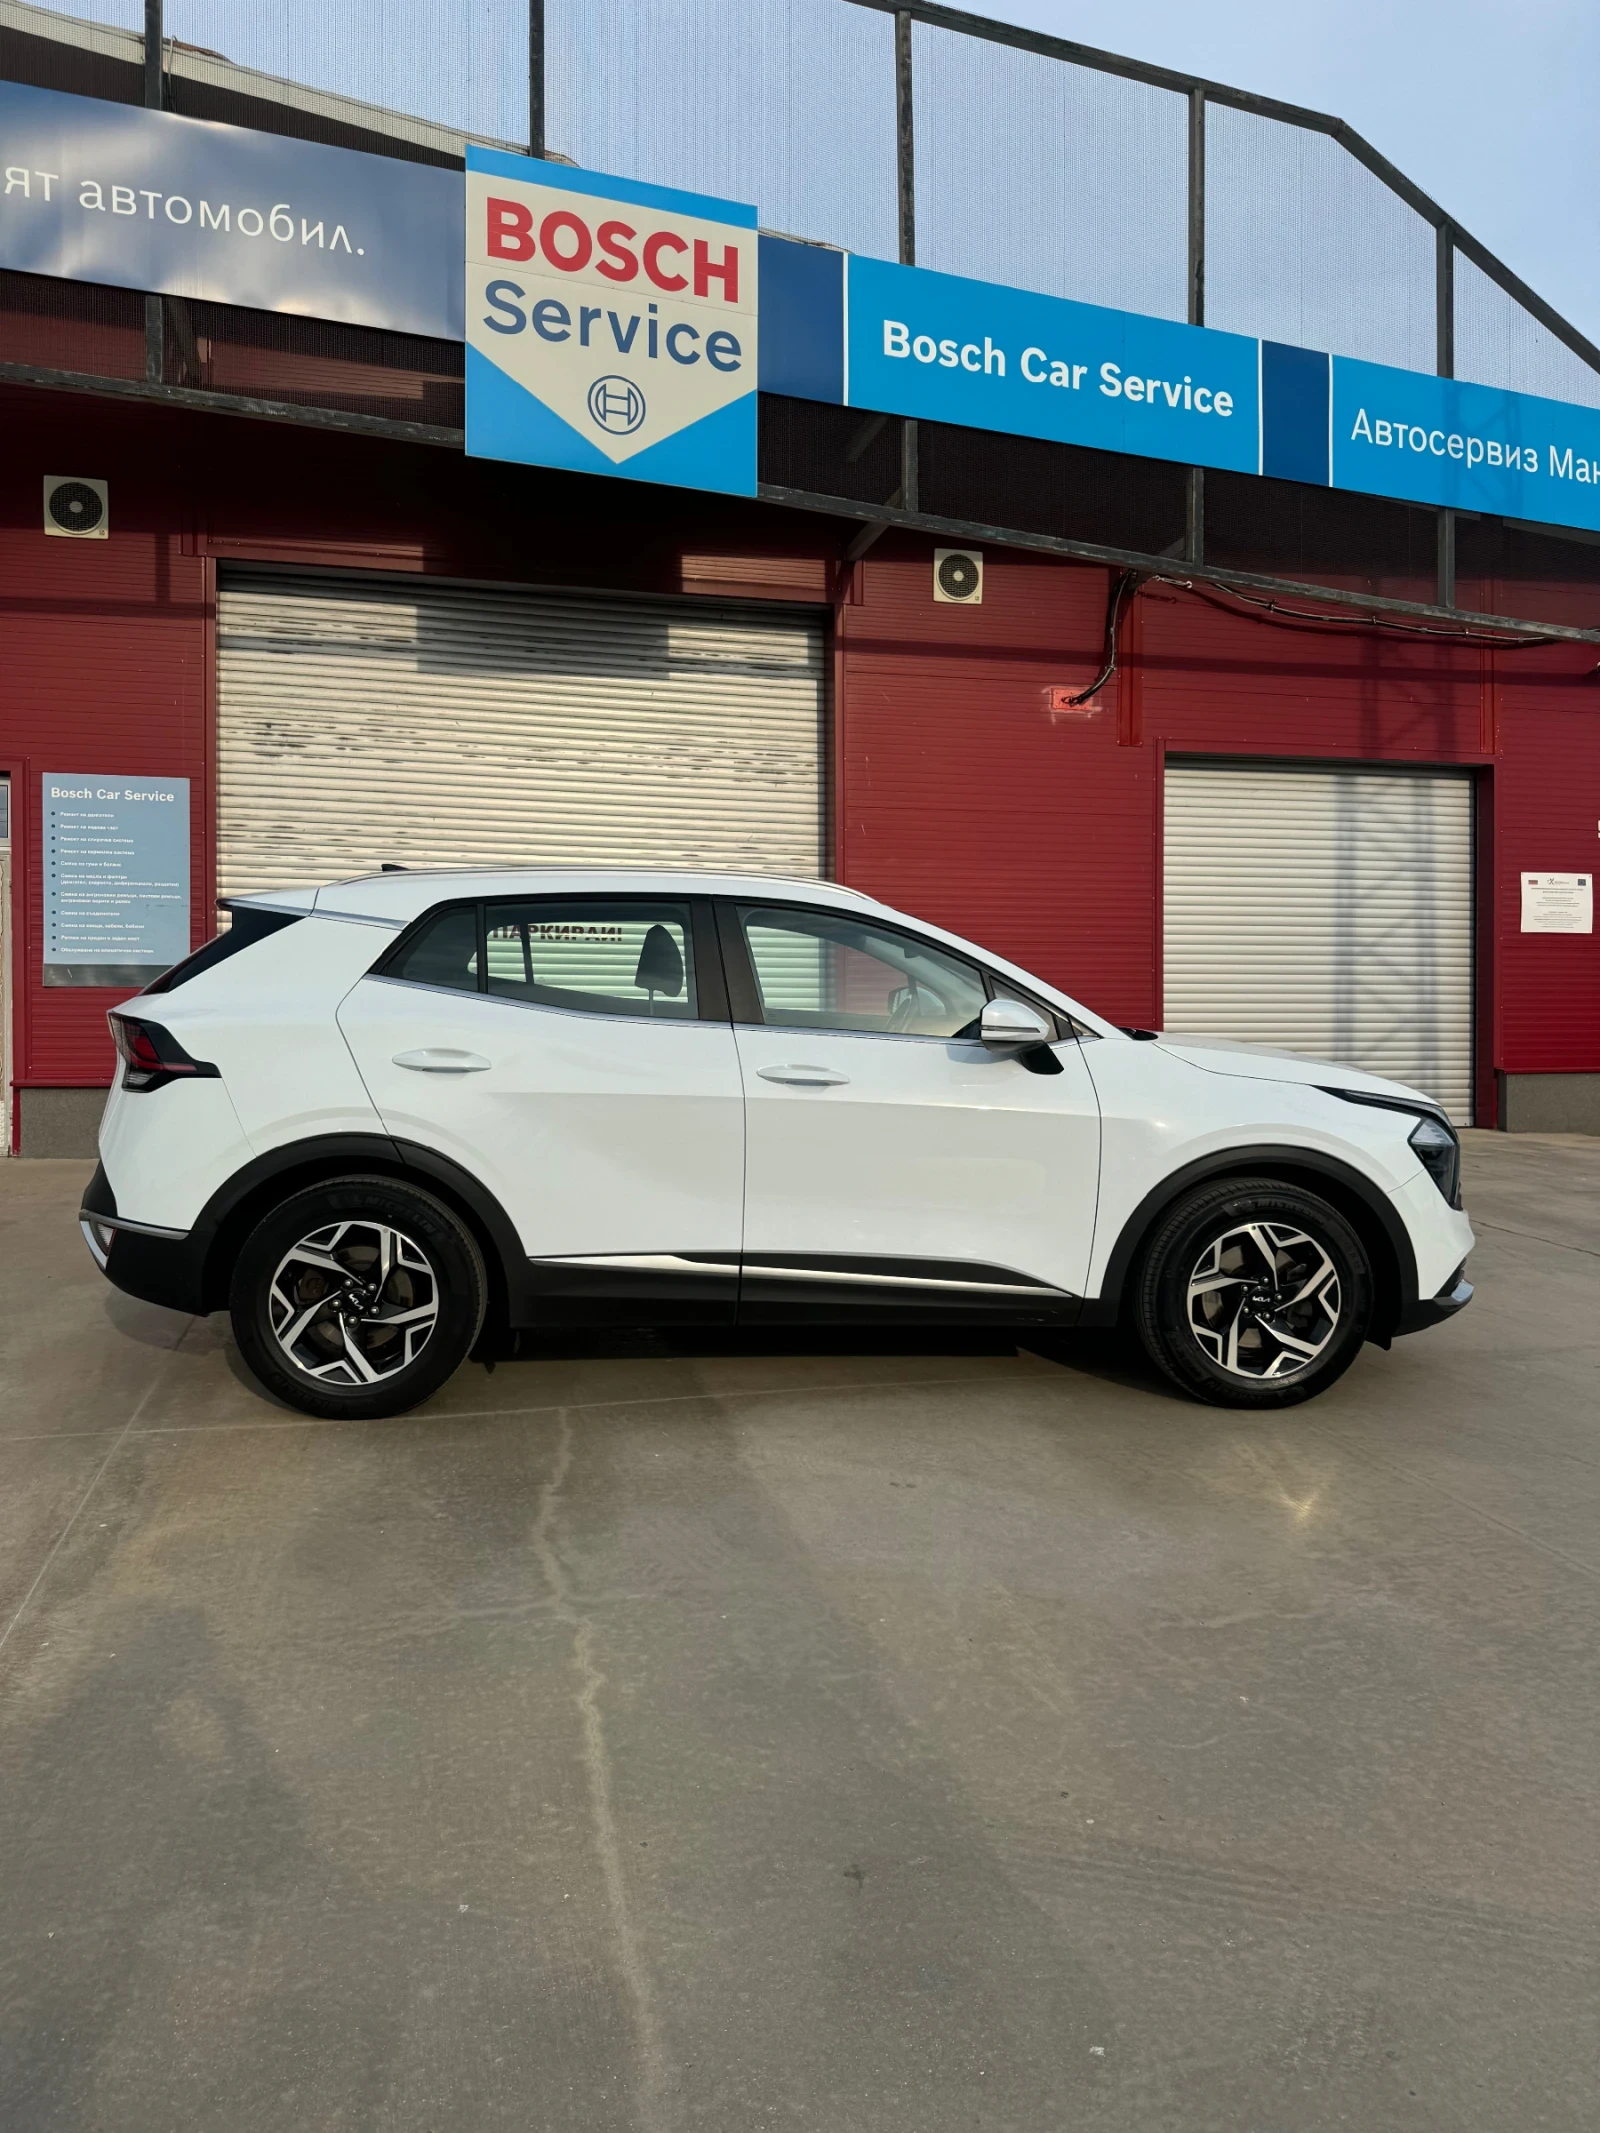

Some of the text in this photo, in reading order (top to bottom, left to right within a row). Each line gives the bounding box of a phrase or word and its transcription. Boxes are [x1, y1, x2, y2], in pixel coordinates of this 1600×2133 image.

[79, 179, 366, 256] автомобил.
[486, 196, 739, 304] BOSCH
[482, 279, 743, 373] Service
[882, 318, 1234, 417] Bosch Car Service
[1350, 407, 1539, 474] Автосервиз
[51, 787, 176, 802] Bosch Car Service
